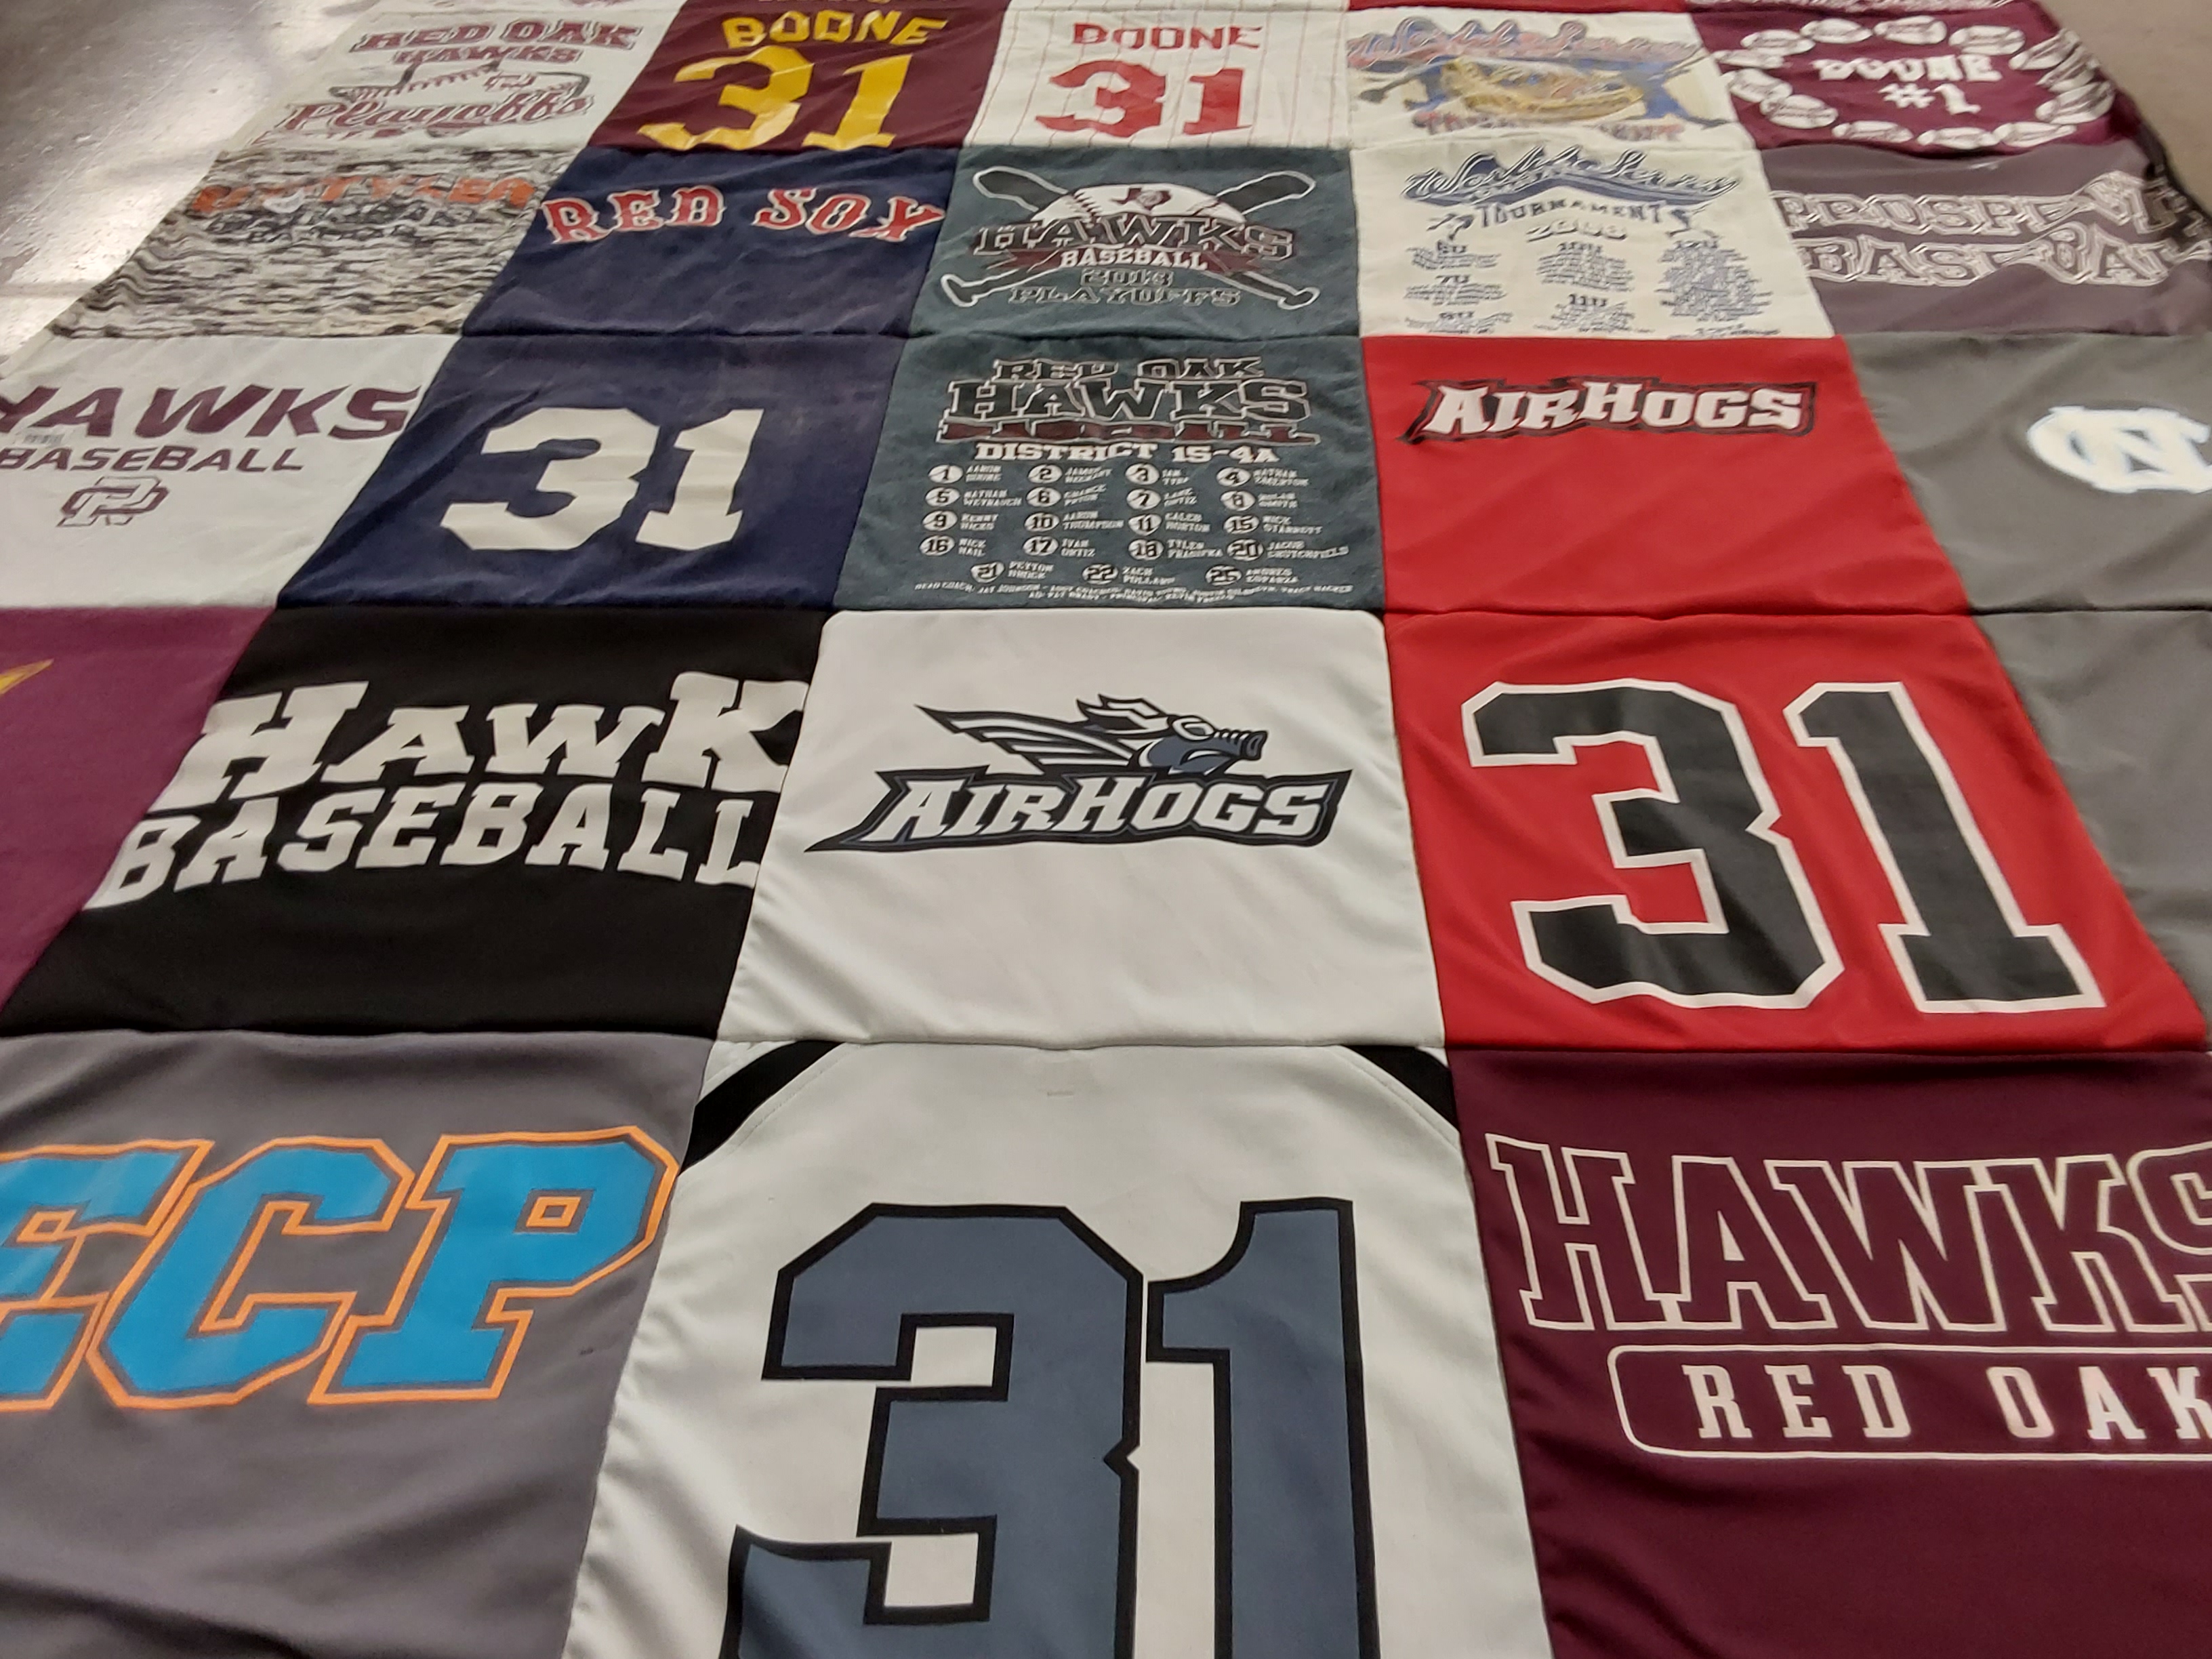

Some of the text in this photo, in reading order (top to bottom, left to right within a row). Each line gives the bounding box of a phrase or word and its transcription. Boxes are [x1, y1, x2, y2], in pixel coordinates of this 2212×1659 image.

[349, 19, 644, 52] RED OAK
[722, 10, 947, 48] BOONE
[1072, 23, 1263, 49] BOONE
[638, 45, 912, 151] 31
[1036, 60, 1252, 138] 31
[1877, 83, 1982, 115] #1
[543, 186, 728, 243] RED
[753, 188, 945, 241] SOX
[972, 212, 1294, 261] HAWKS
[1059, 247, 1208, 270] BASEBALL
[1008, 285, 1242, 306] PLAYOFFS
[991, 356, 1265, 381] RED OAK
[944, 378, 1313, 423] HAWKS
[0, 445, 305, 472] BASEBALL
[975, 442, 1280, 465] DISTRICT 15-4A
[441, 407, 764, 551] 31
[1032, 516, 1054, 529] 10
[1138, 518, 1153, 531] 11
[1230, 519, 1253, 531] 15
[927, 539, 949, 553] 16
[1030, 539, 1053, 553] 17
[978, 565, 998, 579] 21
[1088, 567, 1115, 580] 22
[1210, 569, 1238, 581] 25
[148, 672, 809, 813] HAWK
[81, 781, 760, 910] BASEBALL
[1461, 678, 2106, 1013] 31
[1681, 1364, 2212, 1440] RED OAK
[718, 1196, 1380, 1659] 31
